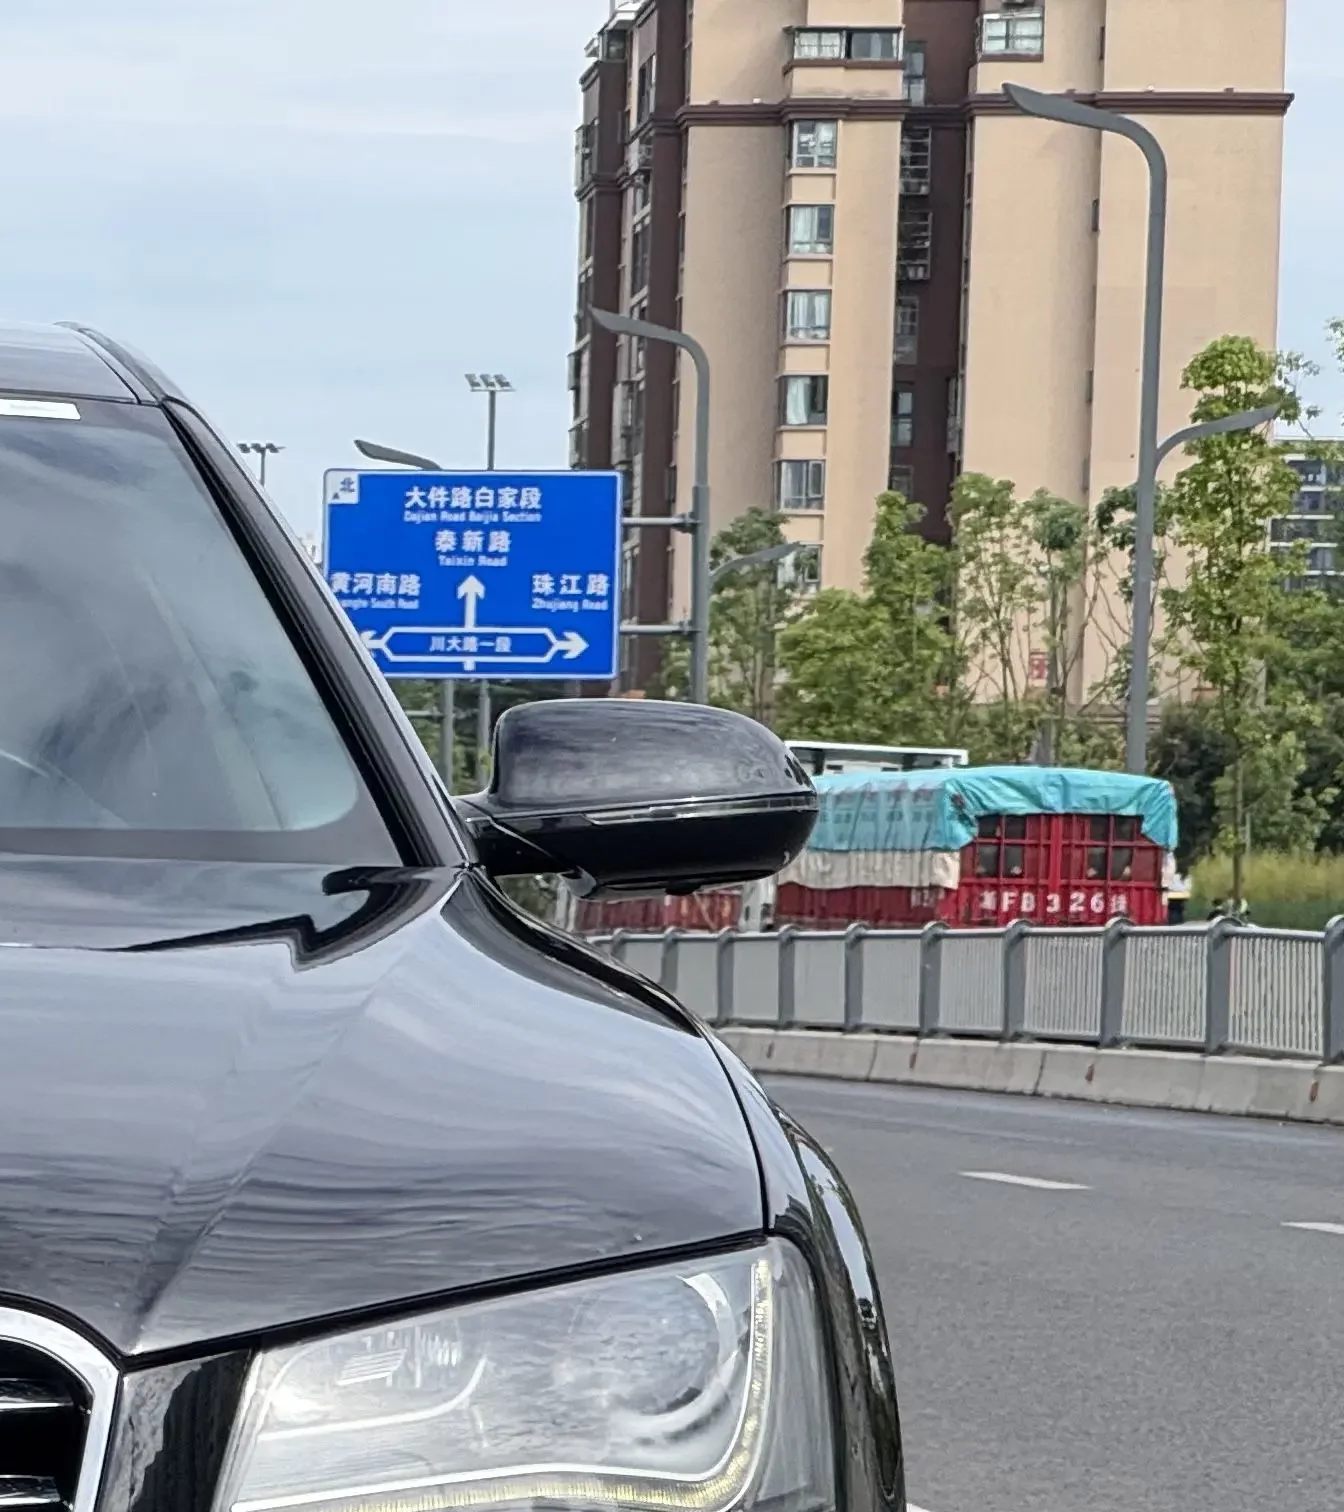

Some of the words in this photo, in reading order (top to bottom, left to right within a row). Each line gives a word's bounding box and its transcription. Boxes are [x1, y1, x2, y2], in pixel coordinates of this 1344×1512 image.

[339, 476, 355, 493] 北
[404, 486, 542, 509] 大件路白家段
[440, 511, 466, 522] Road
[502, 511, 542, 522] Section
[435, 530, 511, 552] 泰新路
[477, 555, 508, 567] Road
[331, 571, 421, 596] 黄河南路
[531, 573, 610, 596] 珠江路
[581, 598, 608, 611] Road
